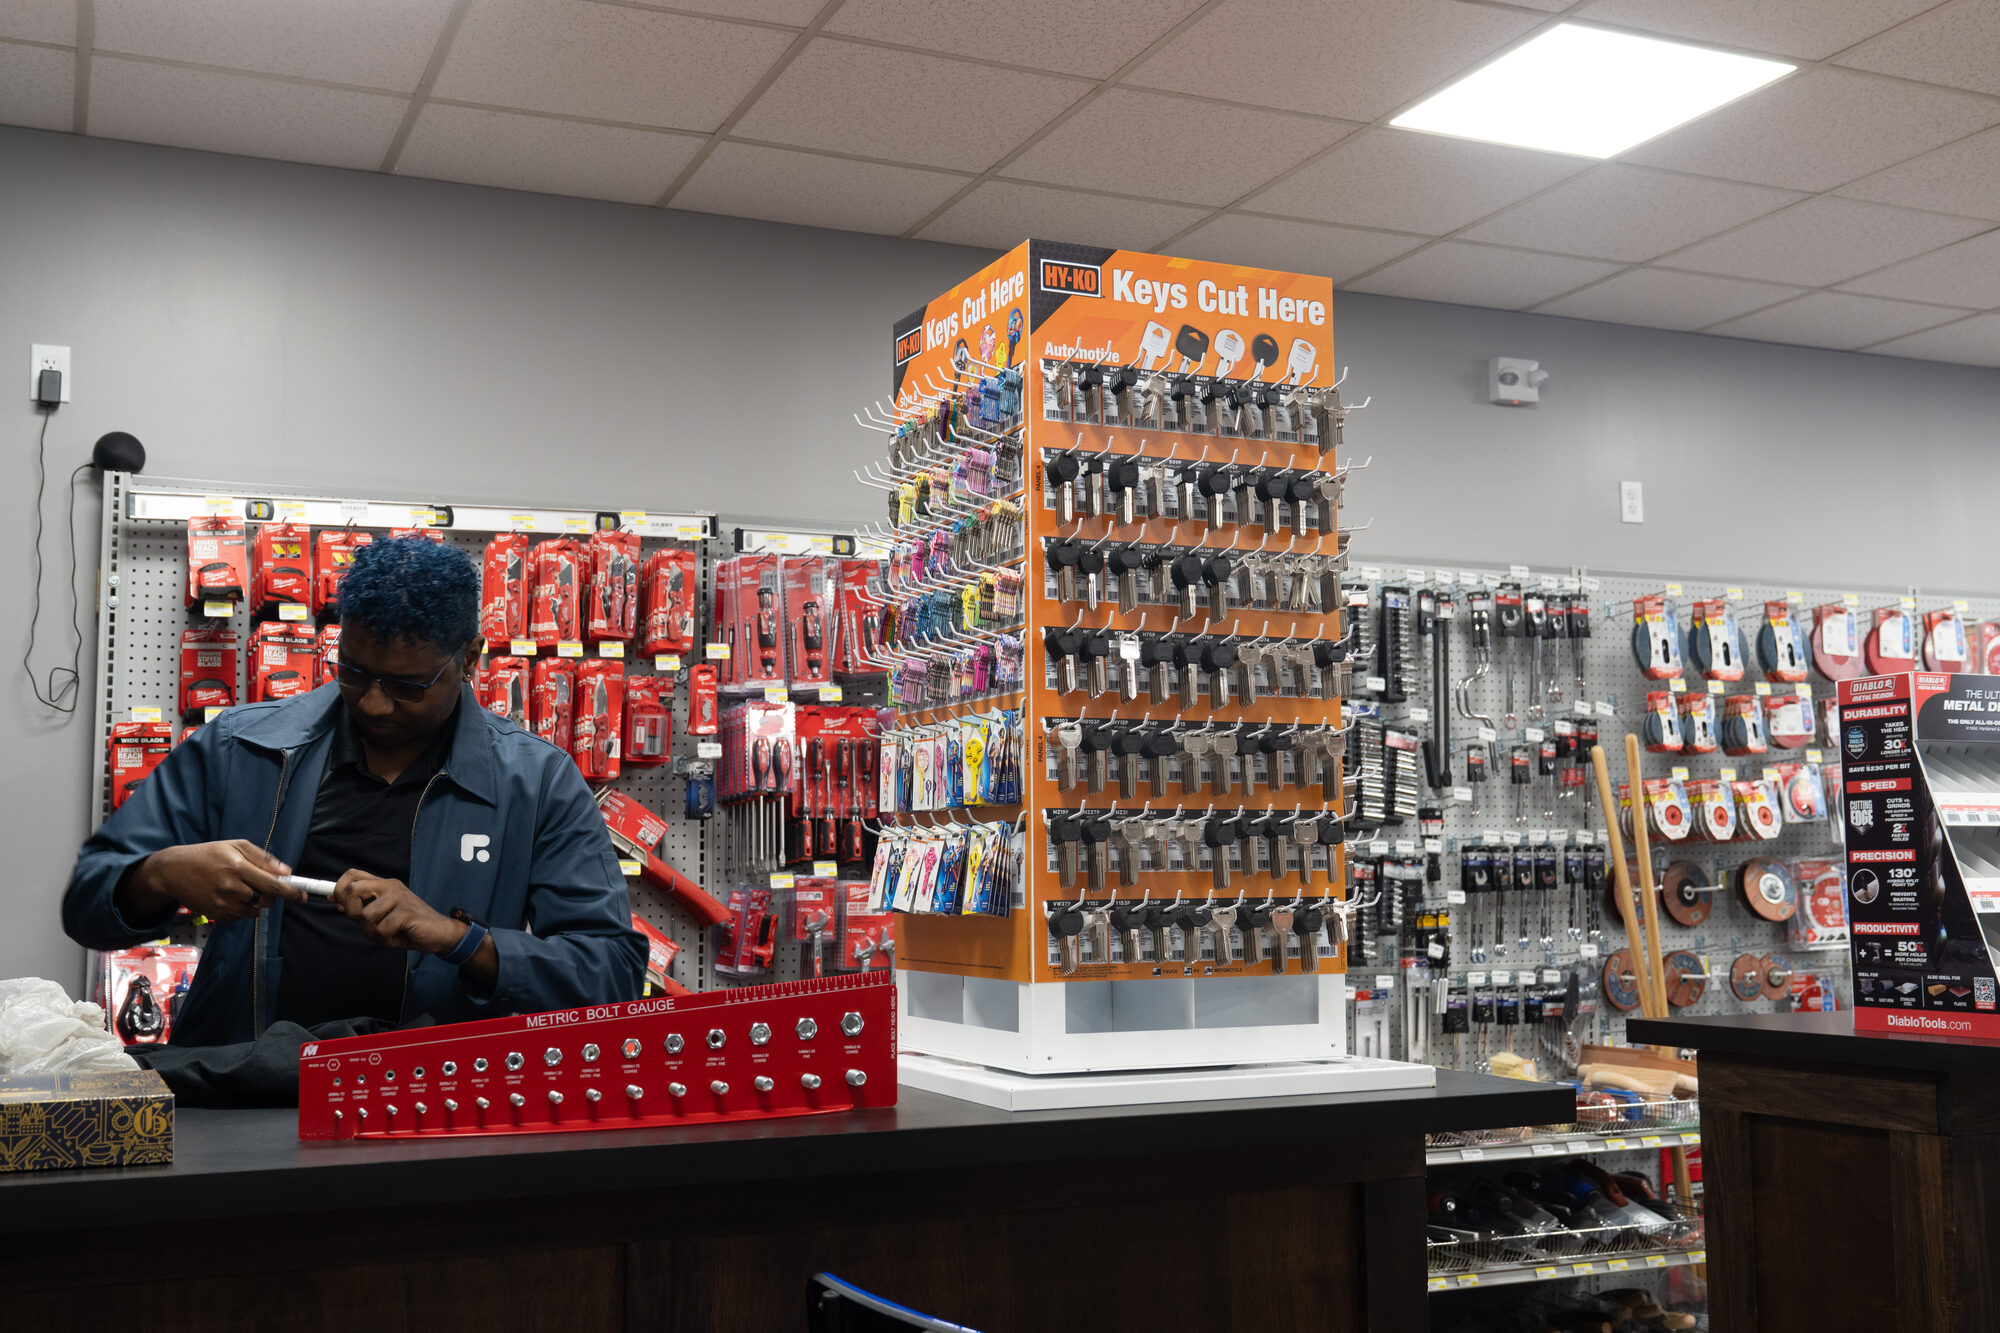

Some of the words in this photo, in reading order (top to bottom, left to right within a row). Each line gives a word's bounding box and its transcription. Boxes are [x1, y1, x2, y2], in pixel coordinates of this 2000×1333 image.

[1045, 264, 1096, 293] HY-KO
[1112, 269, 1186, 313] Keys
[1198, 281, 1248, 318] Cut
[1258, 289, 1326, 326] Here
[926, 310, 959, 351] Keys
[963, 298, 988, 330] Cut
[1001, 269, 1024, 312] Here
[898, 331, 920, 361] HY-KO
[1044, 342, 1120, 362] Automotive
[1853, 680, 1884, 692] DIABLO
[1965, 690, 1982, 699] THE
[1844, 706, 1906, 719] DURABILITY
[1944, 700, 1985, 711] METAL
[1860, 781, 1897, 791] SPEED
[1850, 800, 1872, 809] CUTTING
[1850, 809, 1874, 827] EDGE
[1853, 851, 1913, 861] PRECISION
[1854, 924, 1918, 933] PRODUCTIVITY
[526, 1011, 579, 1028] METRIC
[586, 1006, 621, 1020] BOLT
[627, 999, 675, 1015] GAUGE
[1887, 1015, 1971, 1030] DiabloTools.com
